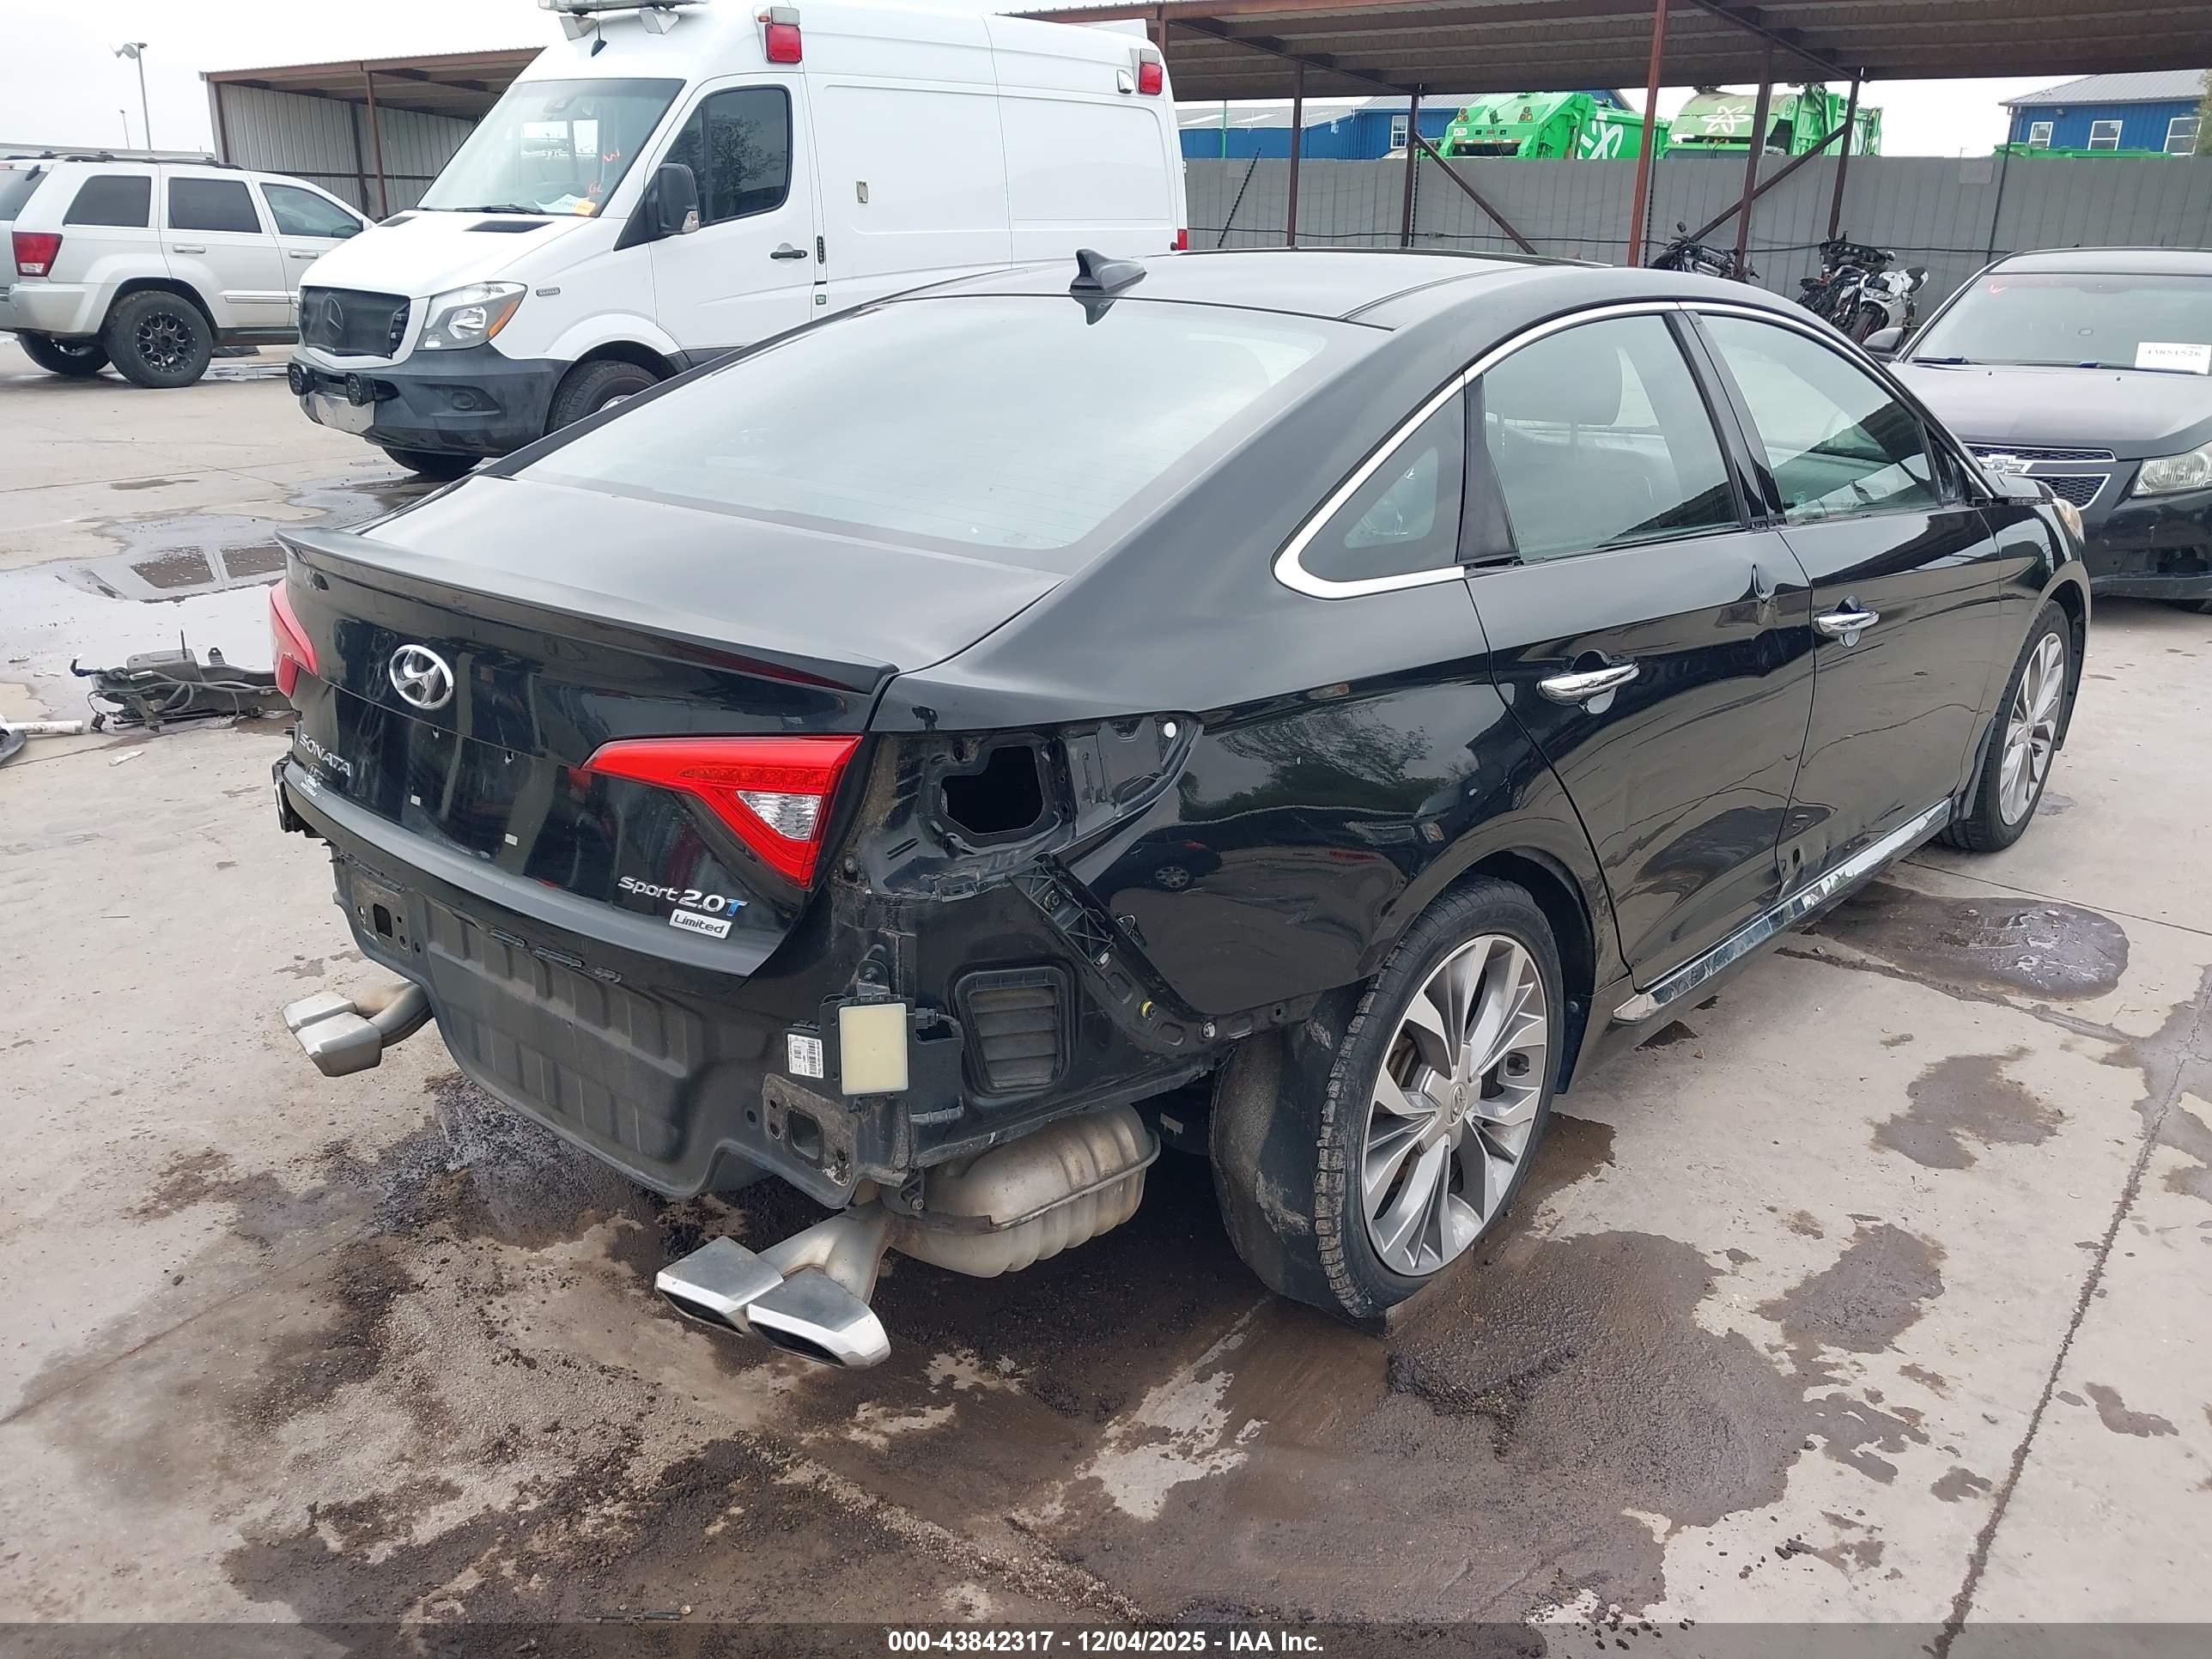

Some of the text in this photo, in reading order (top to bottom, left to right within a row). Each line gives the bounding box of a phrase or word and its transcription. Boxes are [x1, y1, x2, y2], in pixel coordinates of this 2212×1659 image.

[299, 733, 351, 777] SONATA
[618, 876, 679, 902] Sport
[673, 914, 725, 934] Limited
